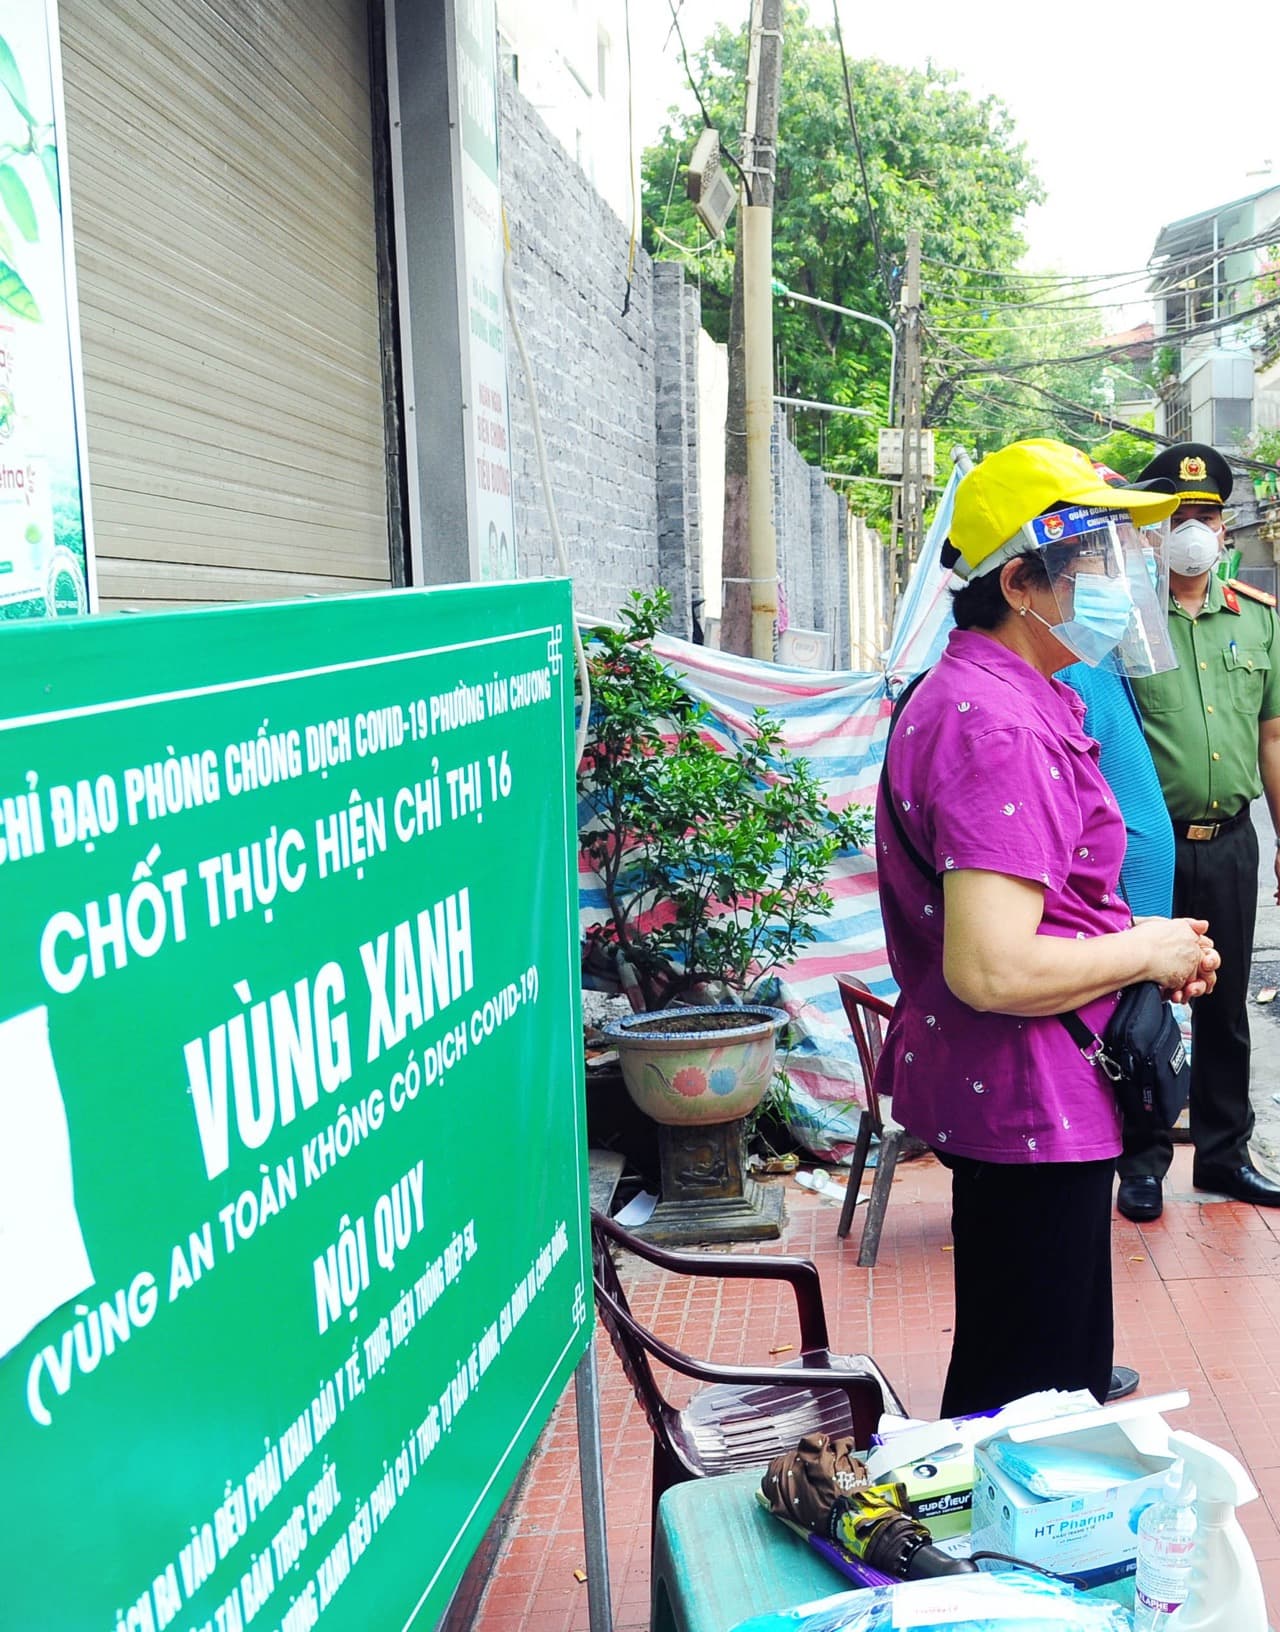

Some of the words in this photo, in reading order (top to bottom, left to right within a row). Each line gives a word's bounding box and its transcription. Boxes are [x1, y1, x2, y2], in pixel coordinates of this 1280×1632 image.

[50, 774, 119, 853] ĐẠO
[124, 745, 219, 825] PHÒNG
[223, 718, 303, 796] CHỐNG
[306, 717, 353, 781] DỊCH
[354, 699, 428, 757] COVID-19
[430, 680, 485, 735] PHƯỜNG
[485, 672, 510, 715] VĂN
[510, 666, 552, 707] CHƯƠNG
[39, 844, 188, 994] CHỐT
[199, 826, 308, 923] THỰC
[315, 788, 388, 880] HIỆN
[393, 756, 441, 843] CHỈ
[446, 761, 484, 825] THỊ
[488, 750, 513, 802] 16
[183, 962, 353, 1181] VÙNG
[358, 886, 474, 1064] XANH
[26, 1271, 159, 1427] (VÙNG
[169, 1221, 215, 1303] AN
[218, 1156, 298, 1252] TOÀN
[302, 1090, 385, 1188] KHÔNG
[388, 1045, 422, 1113] CÓ
[424, 1027, 468, 1089] DỊCH
[470, 964, 540, 1047] COVID-19)
[313, 1214, 371, 1335] NỘI
[373, 1160, 426, 1271] QUY
[178, 1523, 217, 1598] VÀO
[213, 1479, 248, 1560] ĐỀU
[245, 1436, 283, 1523] PHẢI
[279, 1408, 314, 1483] KHAI
[311, 1379, 337, 1445] BÁO
[334, 1367, 345, 1412] Y
[363, 1317, 391, 1380] THỰC
[390, 1289, 416, 1350] HIỆN
[414, 1255, 446, 1320] THÔNG
[443, 1231, 464, 1286] ĐIỆP
[271, 1504, 308, 1582] TRỰC
[316, 1533, 351, 1612] XANH
[348, 1497, 372, 1566] ĐỀU
[370, 1459, 397, 1534] PHẢI
[395, 1440, 411, 1497] CÓ
[1034, 1524, 1055, 1538] HT
